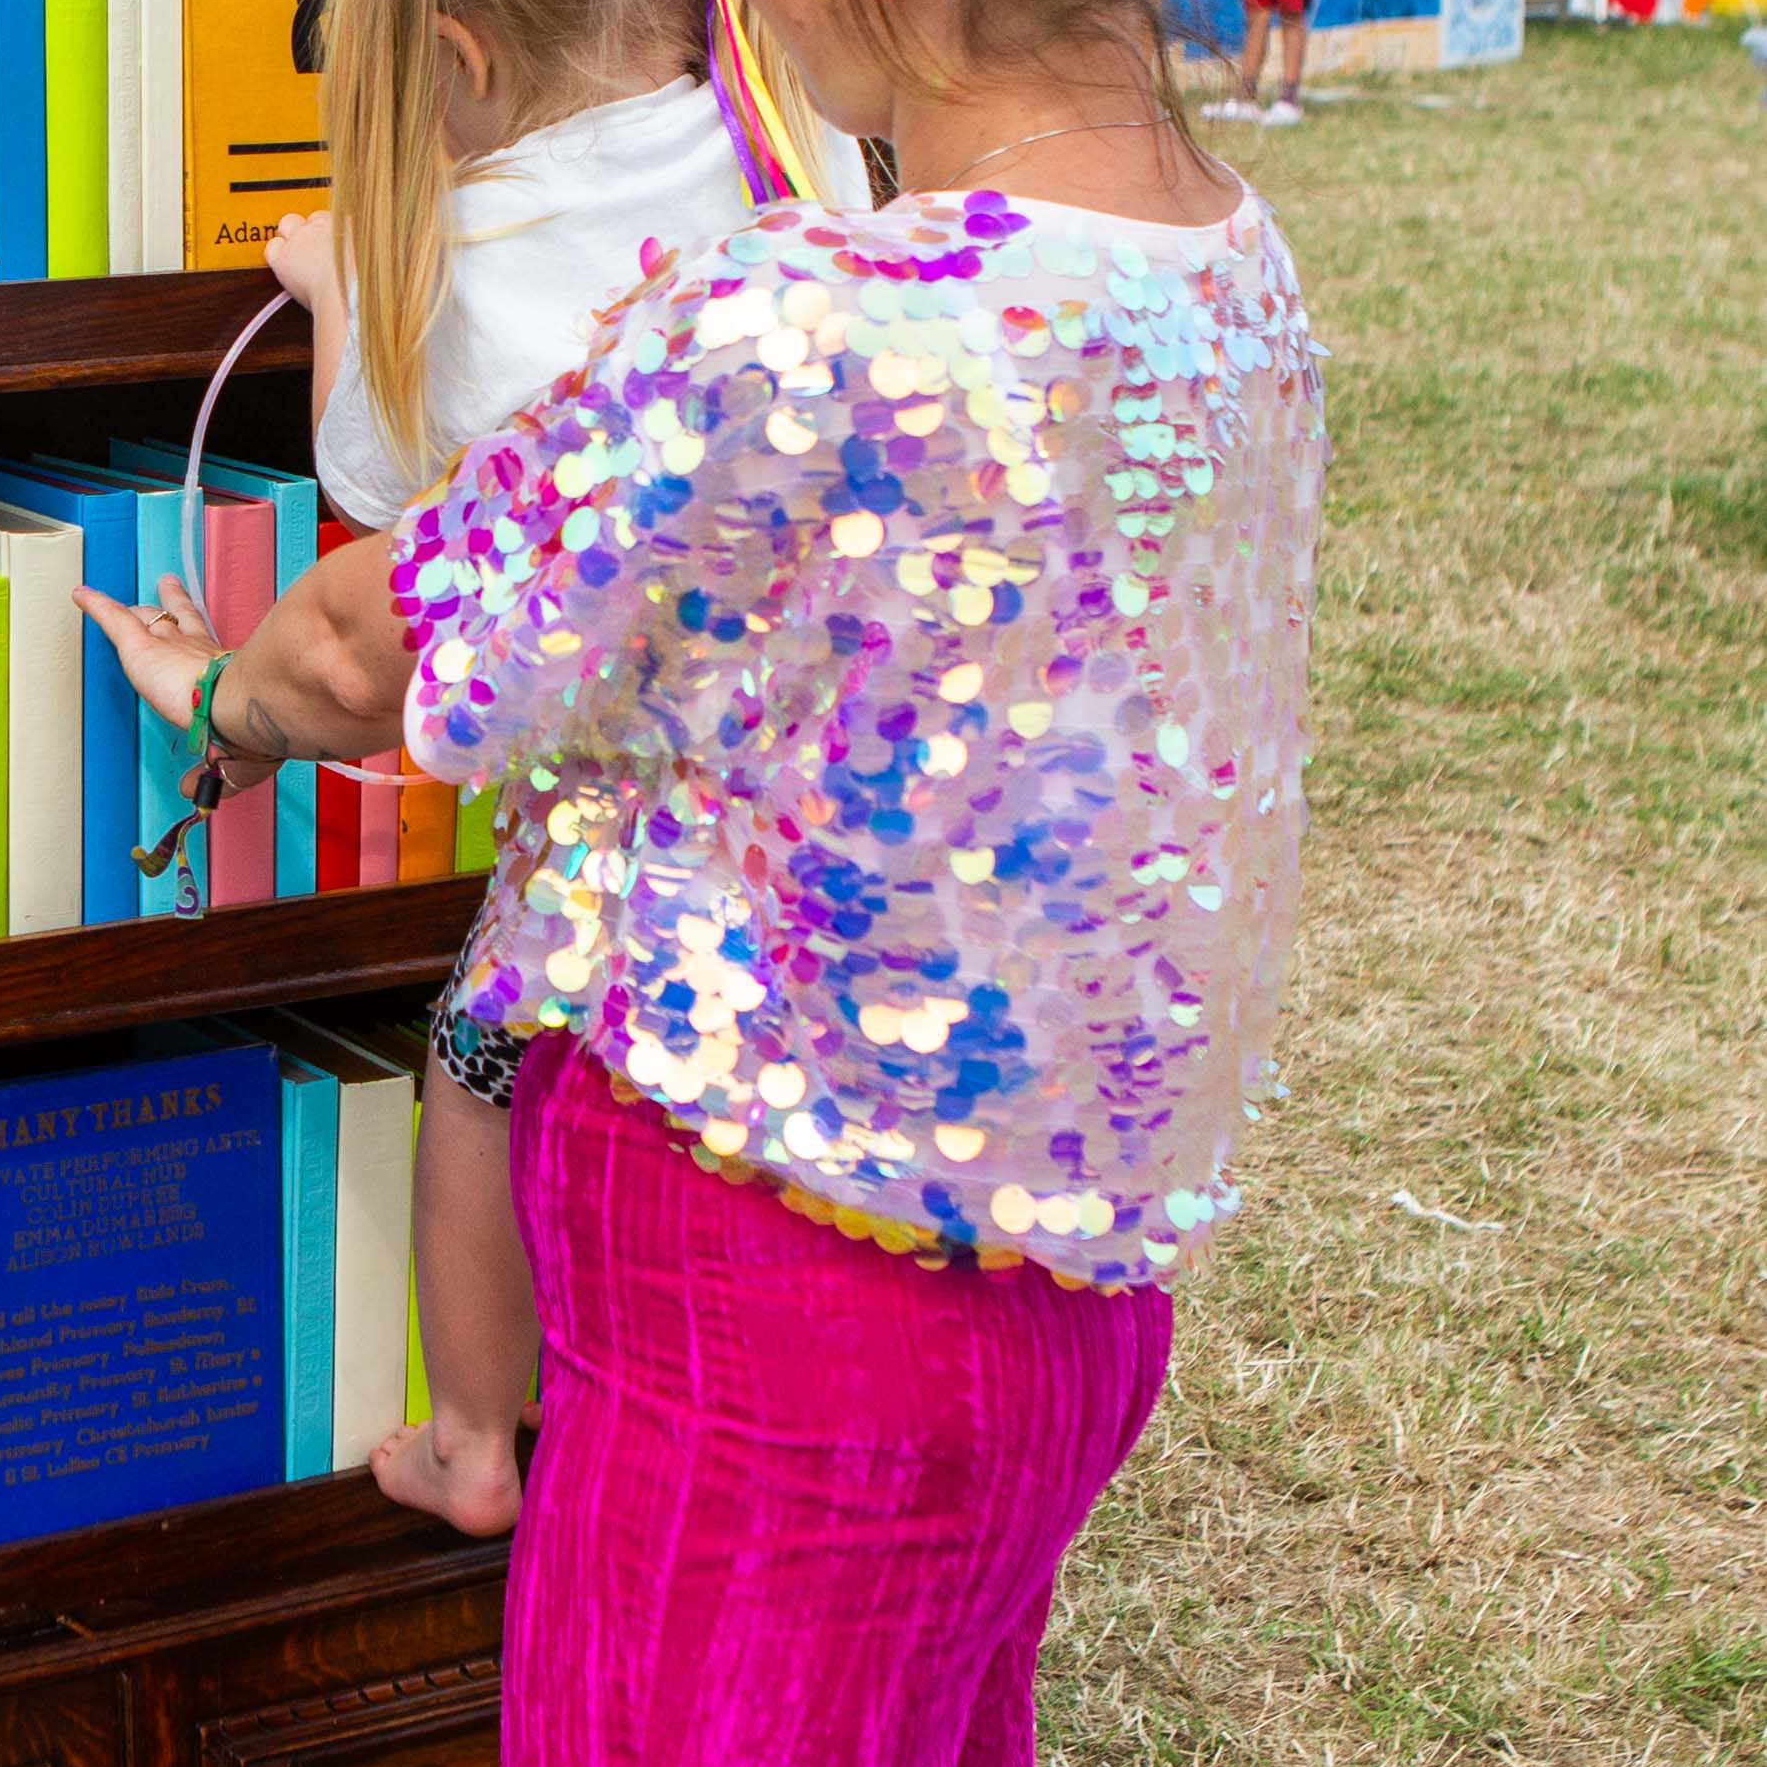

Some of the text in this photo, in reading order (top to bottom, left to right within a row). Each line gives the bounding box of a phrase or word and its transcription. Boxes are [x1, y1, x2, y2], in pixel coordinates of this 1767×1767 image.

[87, 1082, 222, 1131] THANKS
[60, 1138, 199, 1178] PERFORMING
[20, 1170, 137, 1205] CULTURAL
[26, 1197, 91, 1224] COLIN
[12, 1225, 76, 1251] EMMA
[5, 1241, 81, 1274] ALISON
